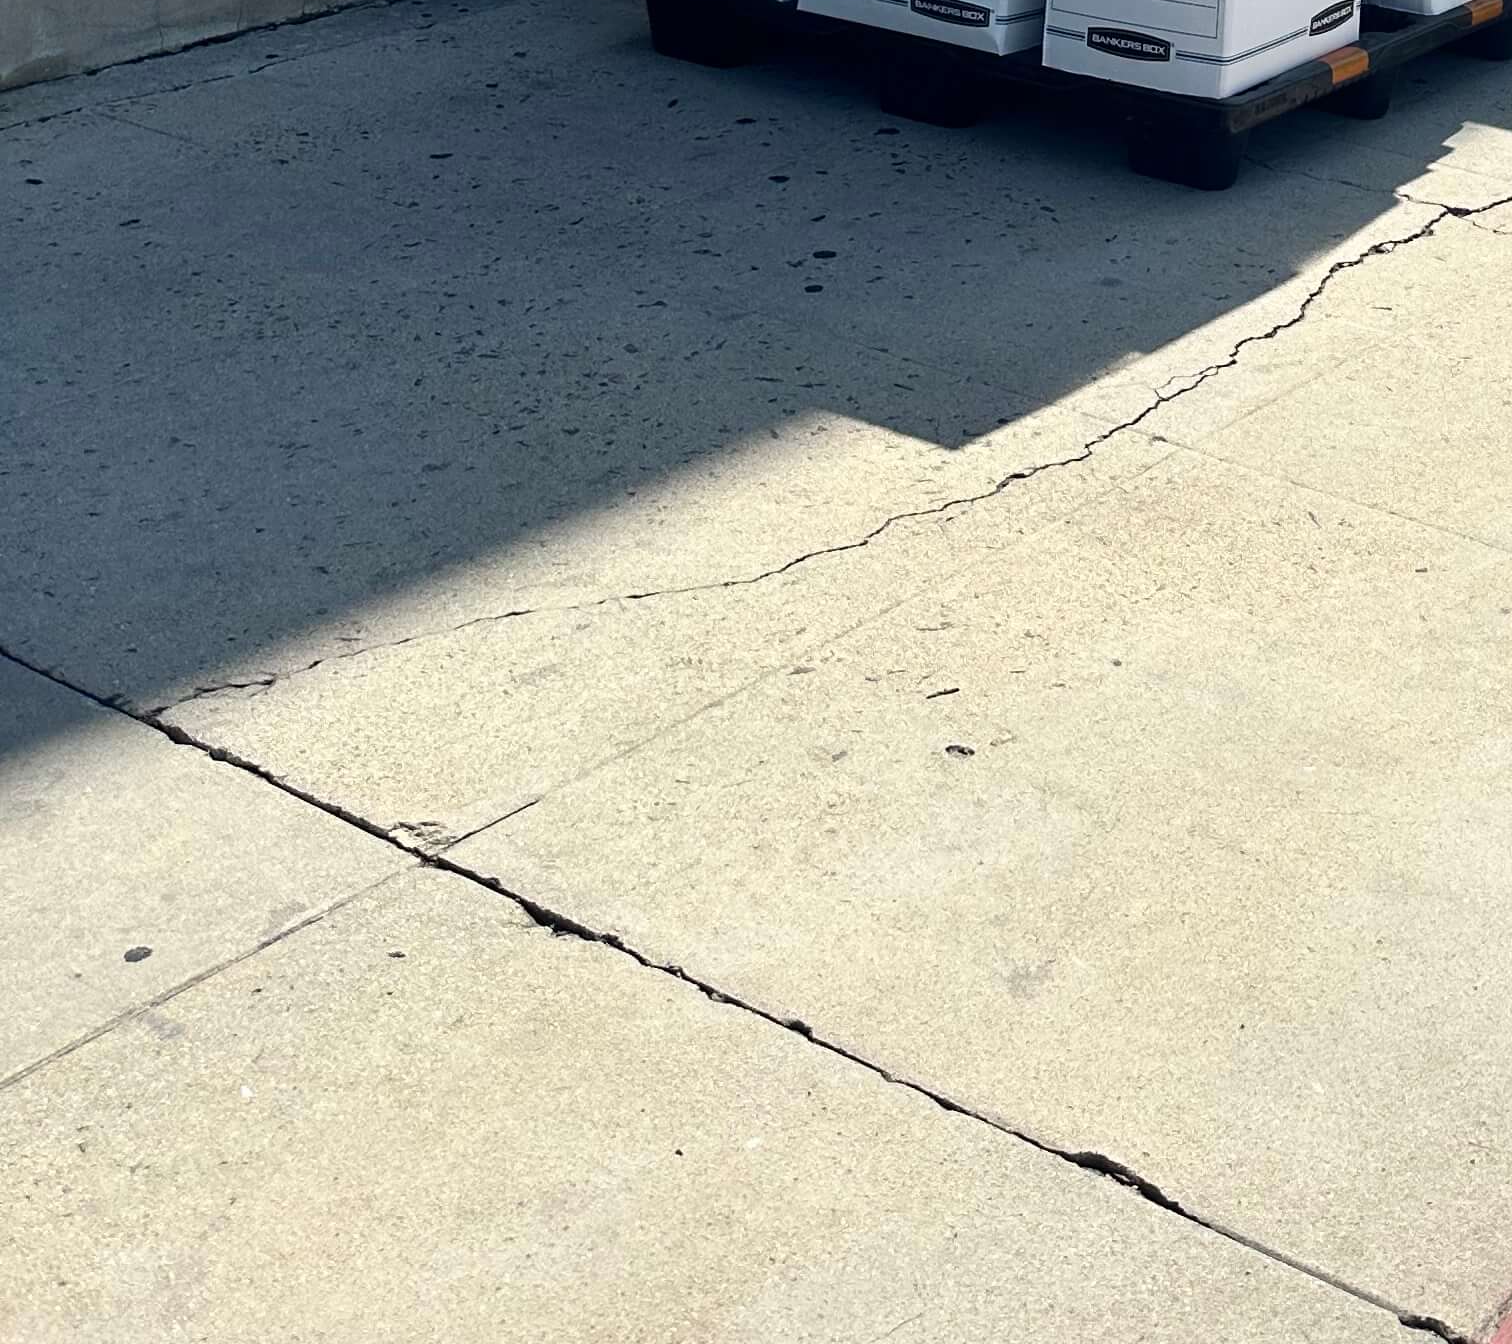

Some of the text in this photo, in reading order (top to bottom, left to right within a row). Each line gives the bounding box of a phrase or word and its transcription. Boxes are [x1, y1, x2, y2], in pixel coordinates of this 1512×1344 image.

[962, 9, 985, 22] BOX
[1091, 32, 1166, 57] BANKERS BOX
